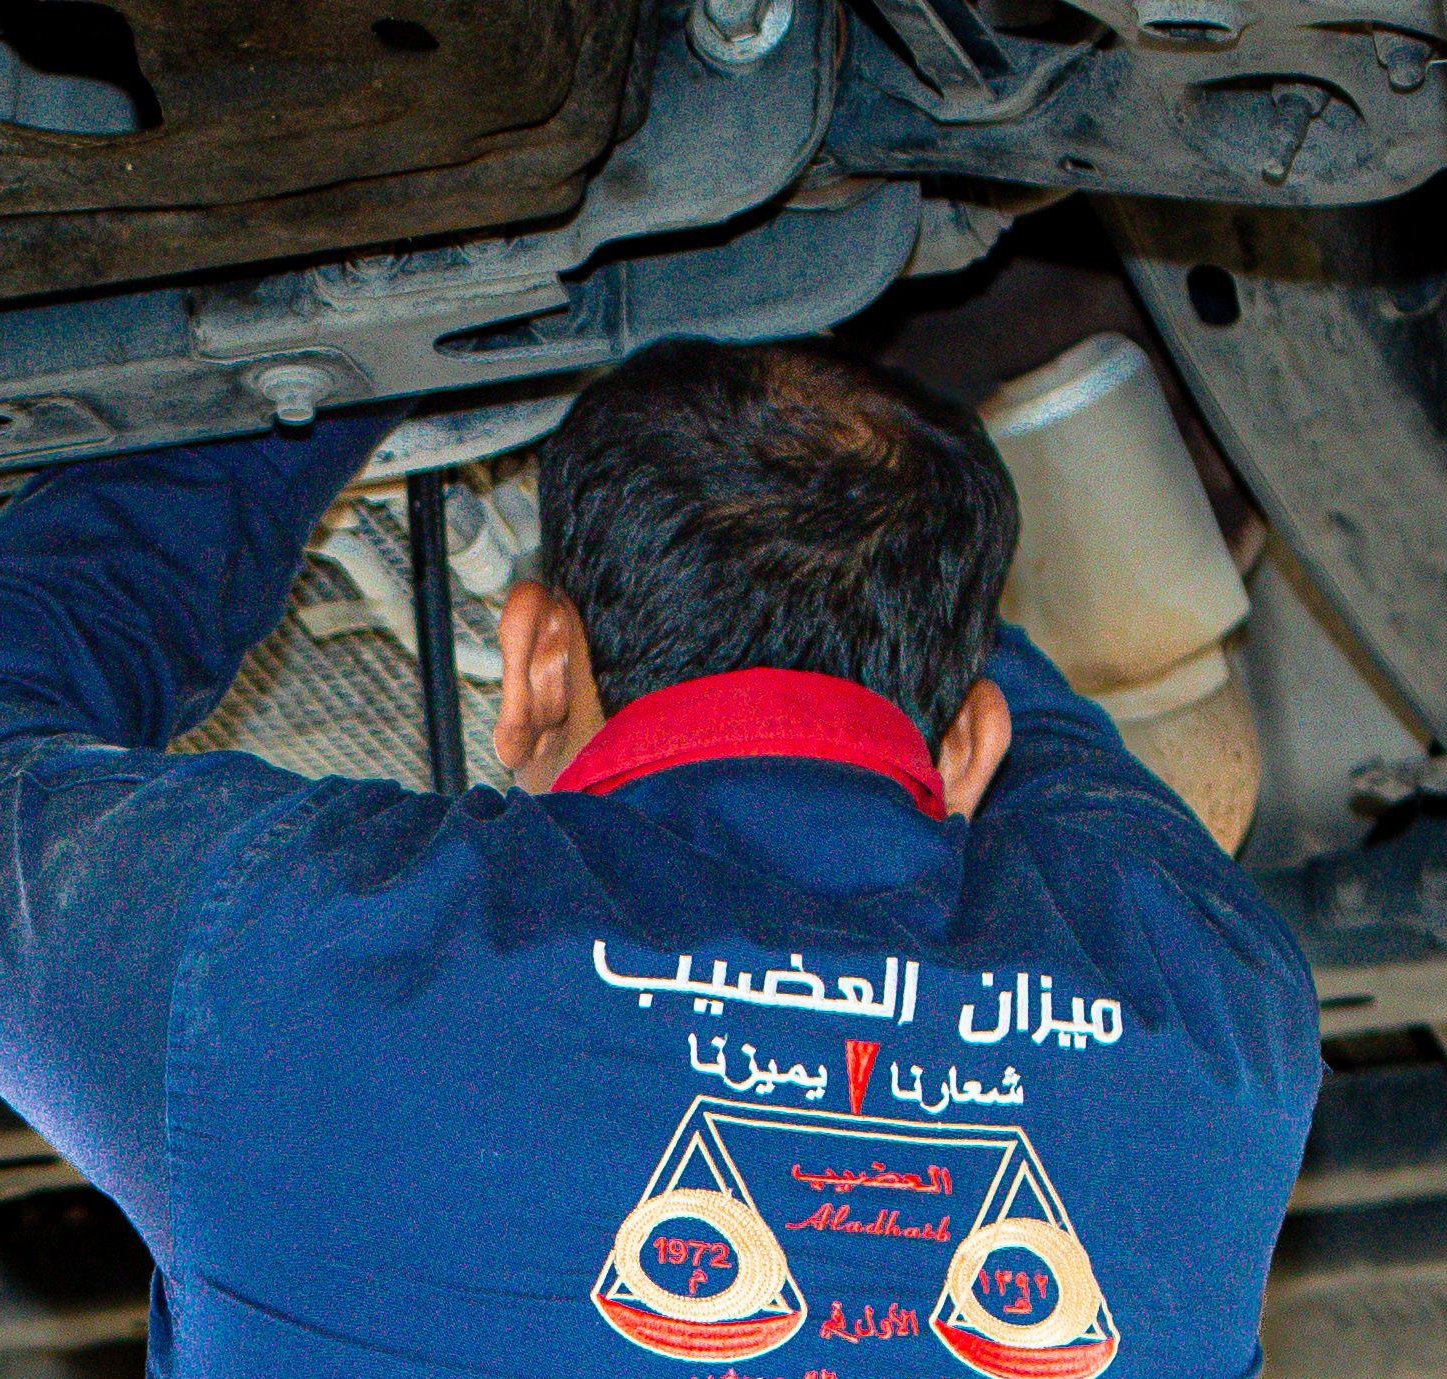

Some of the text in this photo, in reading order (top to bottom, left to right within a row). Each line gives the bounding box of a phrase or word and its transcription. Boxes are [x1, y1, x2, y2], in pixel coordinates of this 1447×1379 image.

[593, 939, 1123, 1049] ميزان العضيب
[688, 1033, 1024, 1114] شعارنا يميزنا
[791, 1161, 953, 1195] العضيب
[652, 1236, 732, 1269] 1972
[689, 1268, 708, 1294] م
